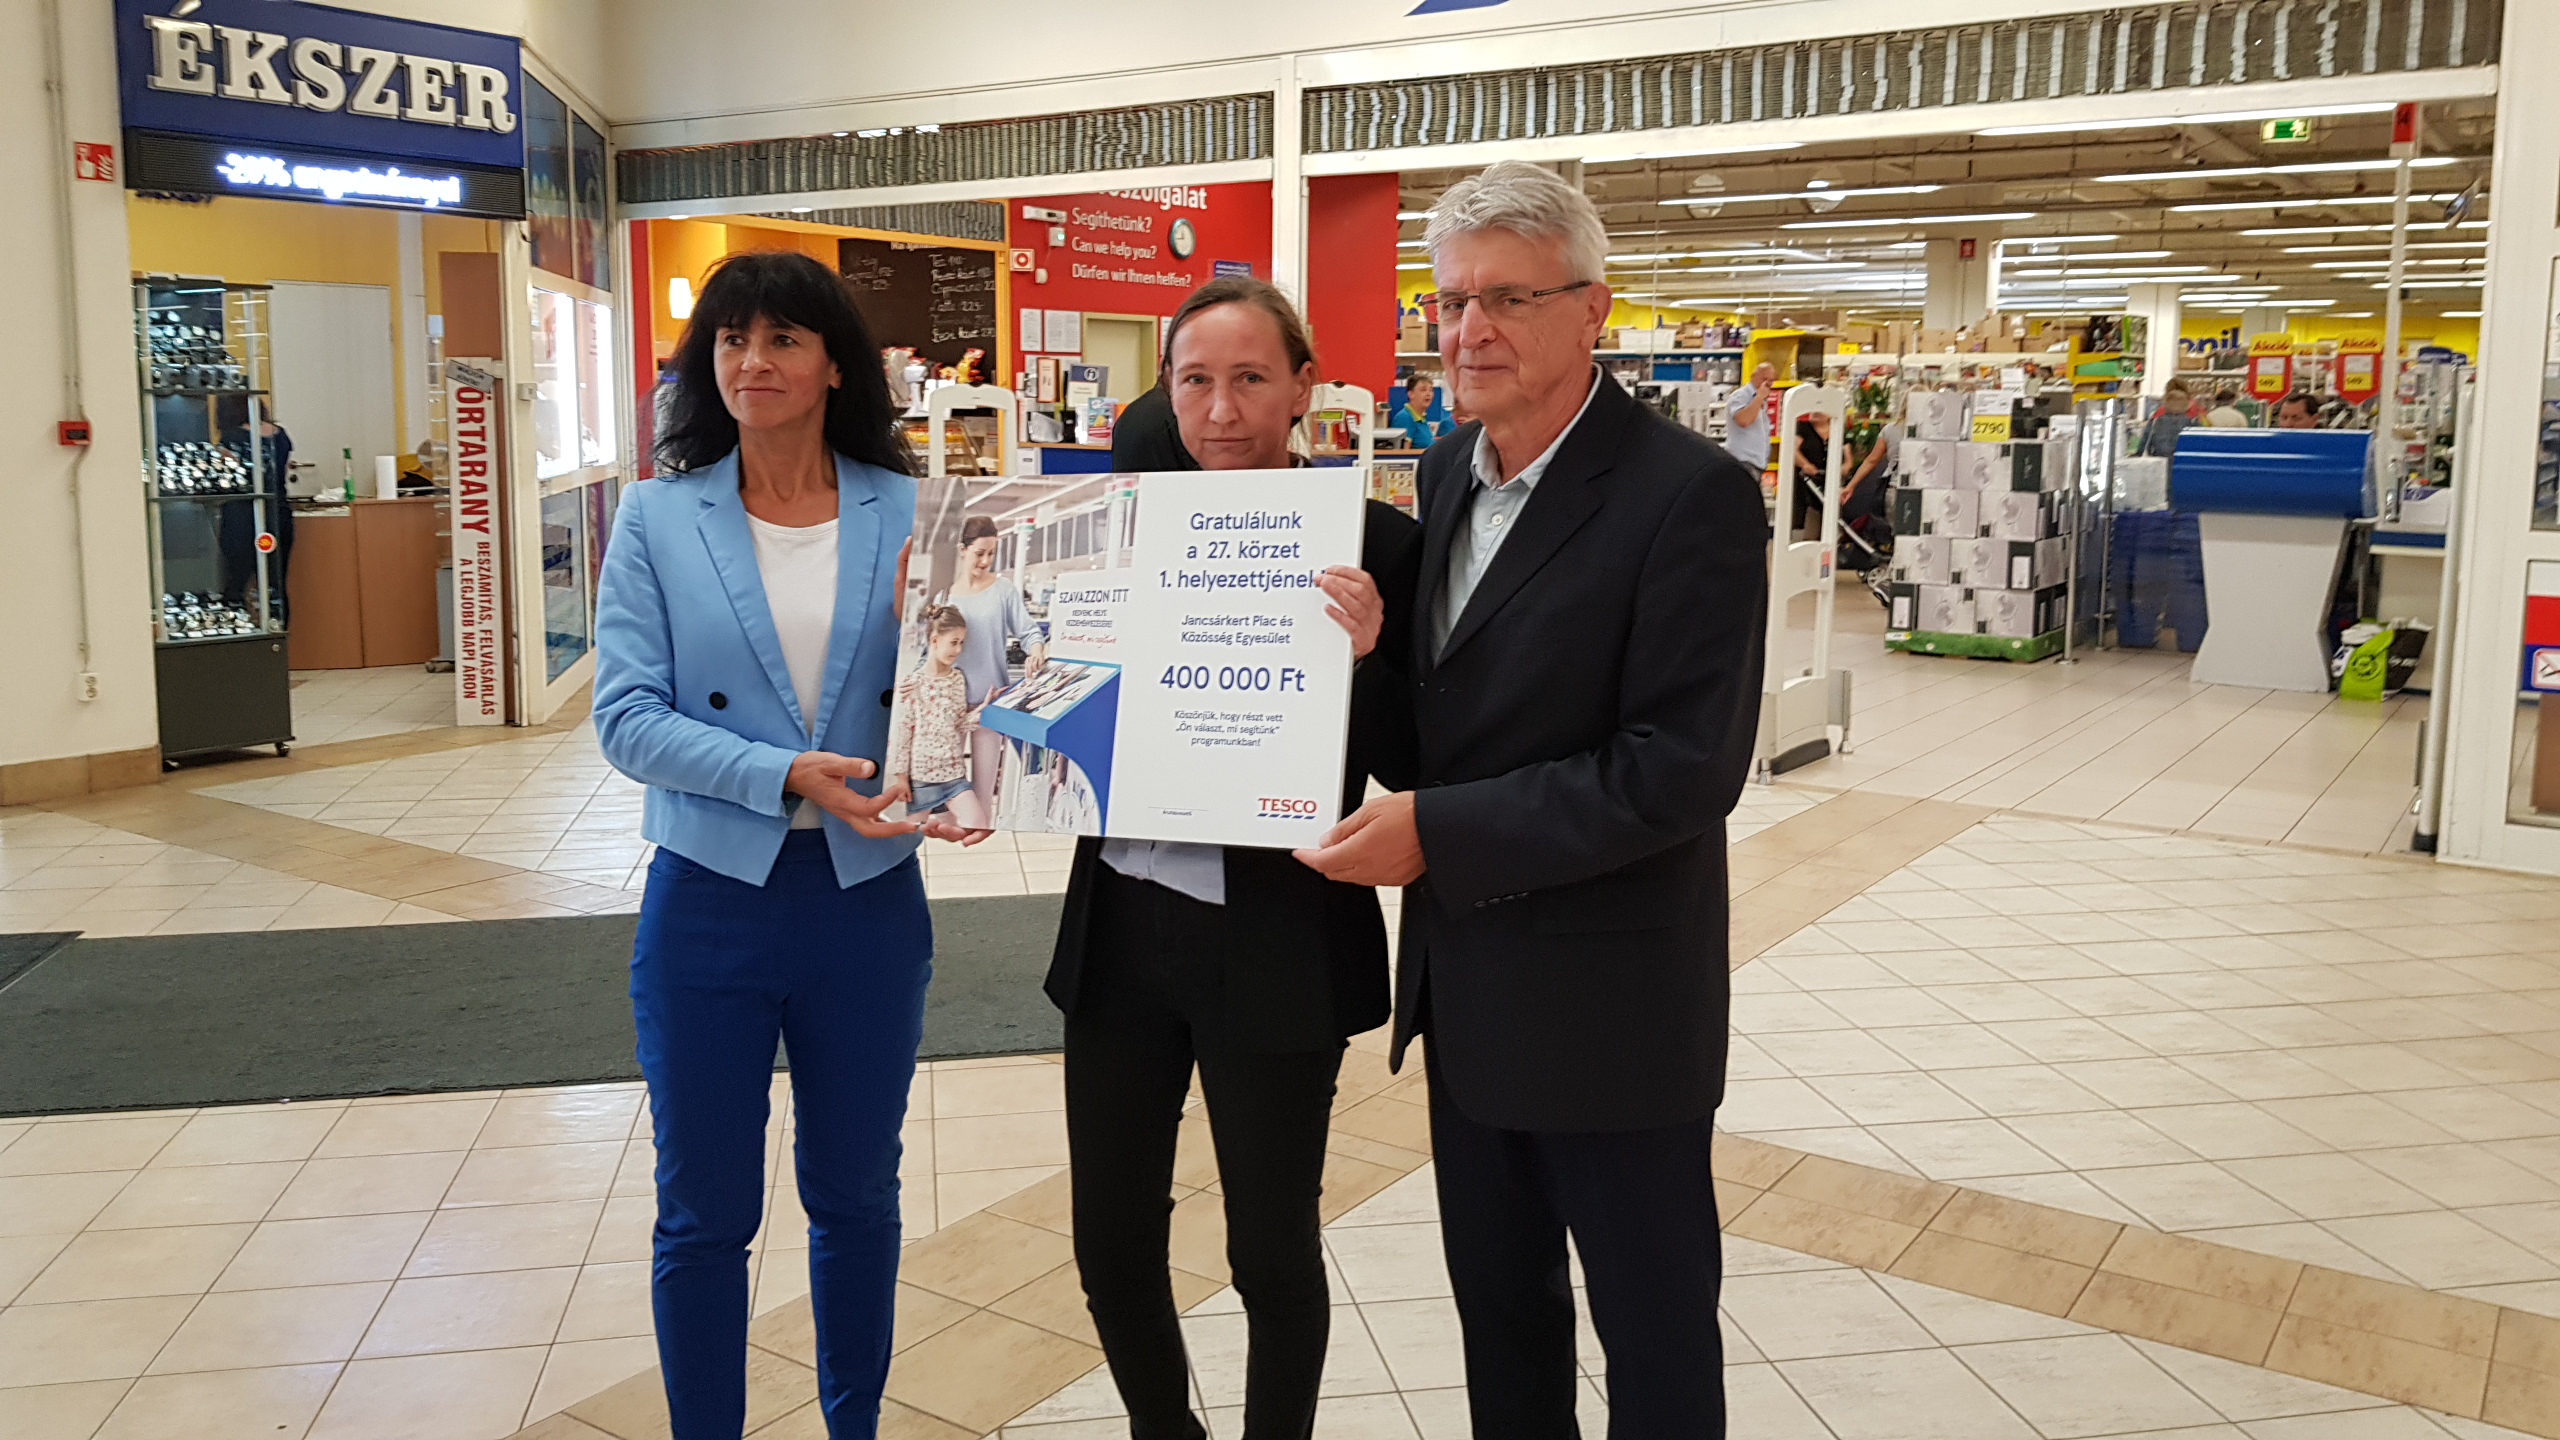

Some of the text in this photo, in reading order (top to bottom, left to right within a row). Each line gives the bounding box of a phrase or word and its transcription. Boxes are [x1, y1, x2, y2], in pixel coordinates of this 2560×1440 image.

[143, 0, 518, 134] ÉKSZER
[1072, 207, 1154, 233] Segíthetünk?
[1072, 236, 1158, 260] Can we help you?
[1072, 263, 1192, 287] Dürfen wir Ihnen helfen?
[1973, 422, 2005, 434] 2790
[456, 386, 492, 535] ÖRTARANY
[1190, 511, 1303, 531] Gratulálunk
[1186, 540, 1301, 559] a 27. körzet
[1159, 570, 1172, 588] 1.
[1059, 588, 1130, 603] SZAVAZZON ITT
[459, 558, 478, 699] A LEGJOBB NAPI ÁRON
[476, 541, 498, 715] BESZÁMÍTÁS, FELVÁSÁRLÁS
[1181, 615, 1293, 627] Jancsárkert Piac és
[1181, 631, 1291, 646] Közösség Egyesület
[1160, 665, 1306, 692] 400 000 Ft
[1220, 711, 1241, 722] hogy
[1242, 712, 1264, 722] részt
[1265, 714, 1284, 722] vett
[1227, 725, 1238, 734] mi
[1191, 737, 1261, 747] programunkban!
[1258, 797, 1318, 814] TESCO
